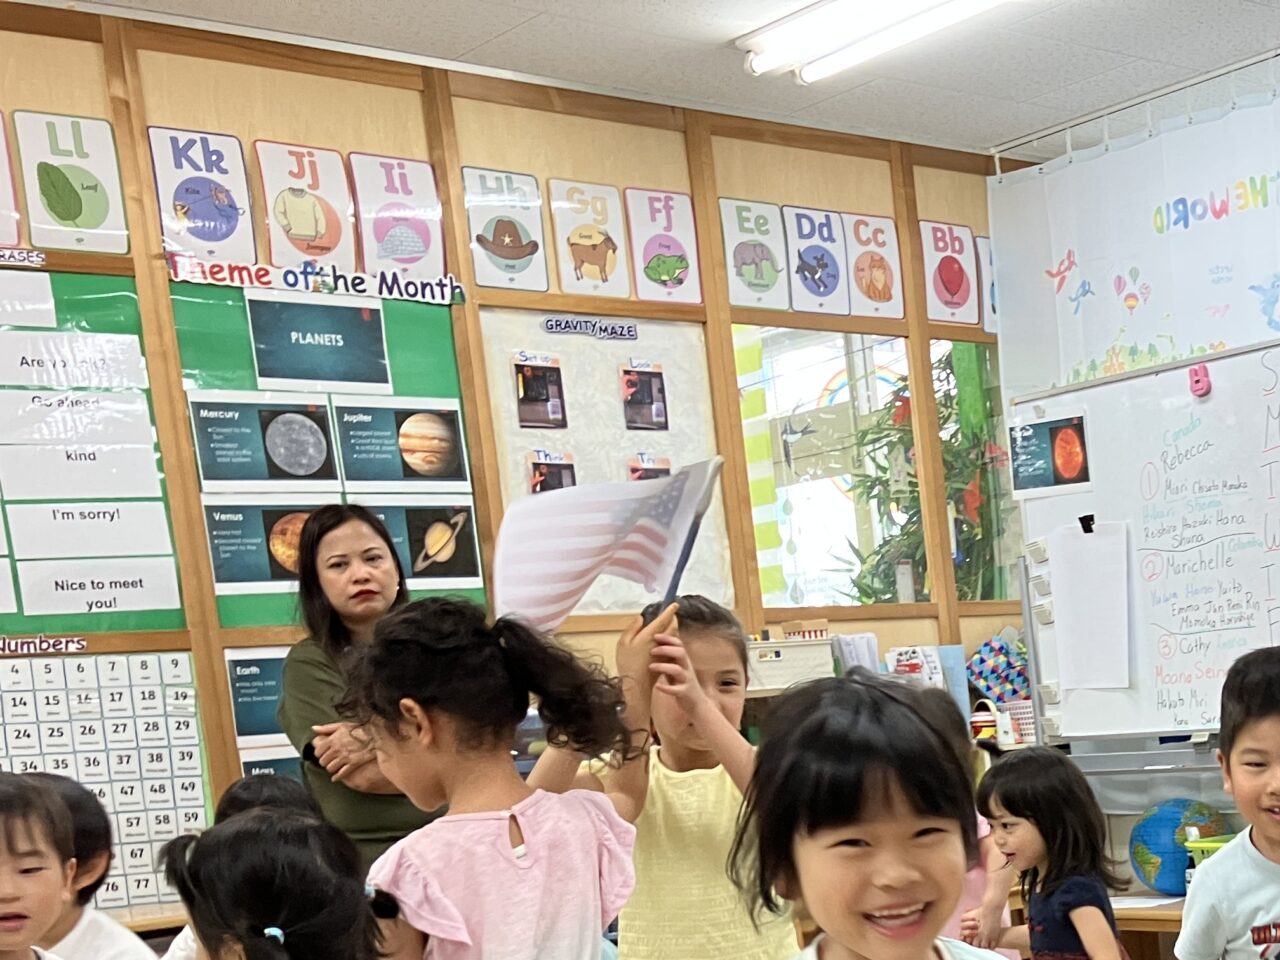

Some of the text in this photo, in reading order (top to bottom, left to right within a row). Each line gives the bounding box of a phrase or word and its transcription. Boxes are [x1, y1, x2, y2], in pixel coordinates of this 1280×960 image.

[46, 120, 89, 159] Ll
[169, 136, 229, 174] Kk
[288, 150, 319, 191] Jj
[379, 161, 413, 195] Ii
[566, 186, 609, 225] Gg
[648, 195, 675, 232] Ff
[735, 206, 771, 235] Ee
[795, 213, 836, 243] Dd
[853, 220, 887, 248] Cc
[932, 227, 965, 255] Bb
[283, 261, 314, 290] of
[378, 271, 465, 303] Month
[545, 319, 635, 337] GRAVITY MAZE
[291, 331, 344, 346] PLANETS
[200, 409, 239, 420] Mercury
[66, 450, 96, 462] kind
[1160, 440, 1215, 474] Rebecca
[1260, 460, 1279, 497] T
[52, 509, 120, 522] I'm sorry!
[213, 512, 243, 521] Venus
[1166, 541, 1235, 579] Marichelle
[54, 579, 144, 592] Nice to meet
[86, 599, 117, 612] you!
[11, 659, 179, 675] 4 5 6 7 8 9
[236, 666, 260, 676] Earth
[12, 697, 27, 707] 14
[44, 695, 60, 706] 15
[110, 692, 124, 702] 17
[141, 690, 156, 700] 18
[174, 691, 188, 701] 19
[14, 720, 190, 740] 24 25 26 27 28 29
[21, 751, 194, 771] 34 35 36 37 38 39
[120, 786, 134, 795] 47
[150, 784, 166, 793] 48
[181, 782, 195, 791] 49
[126, 812, 198, 827] 57 58 59
[130, 848, 144, 858] 67
[134, 879, 150, 889] 77
